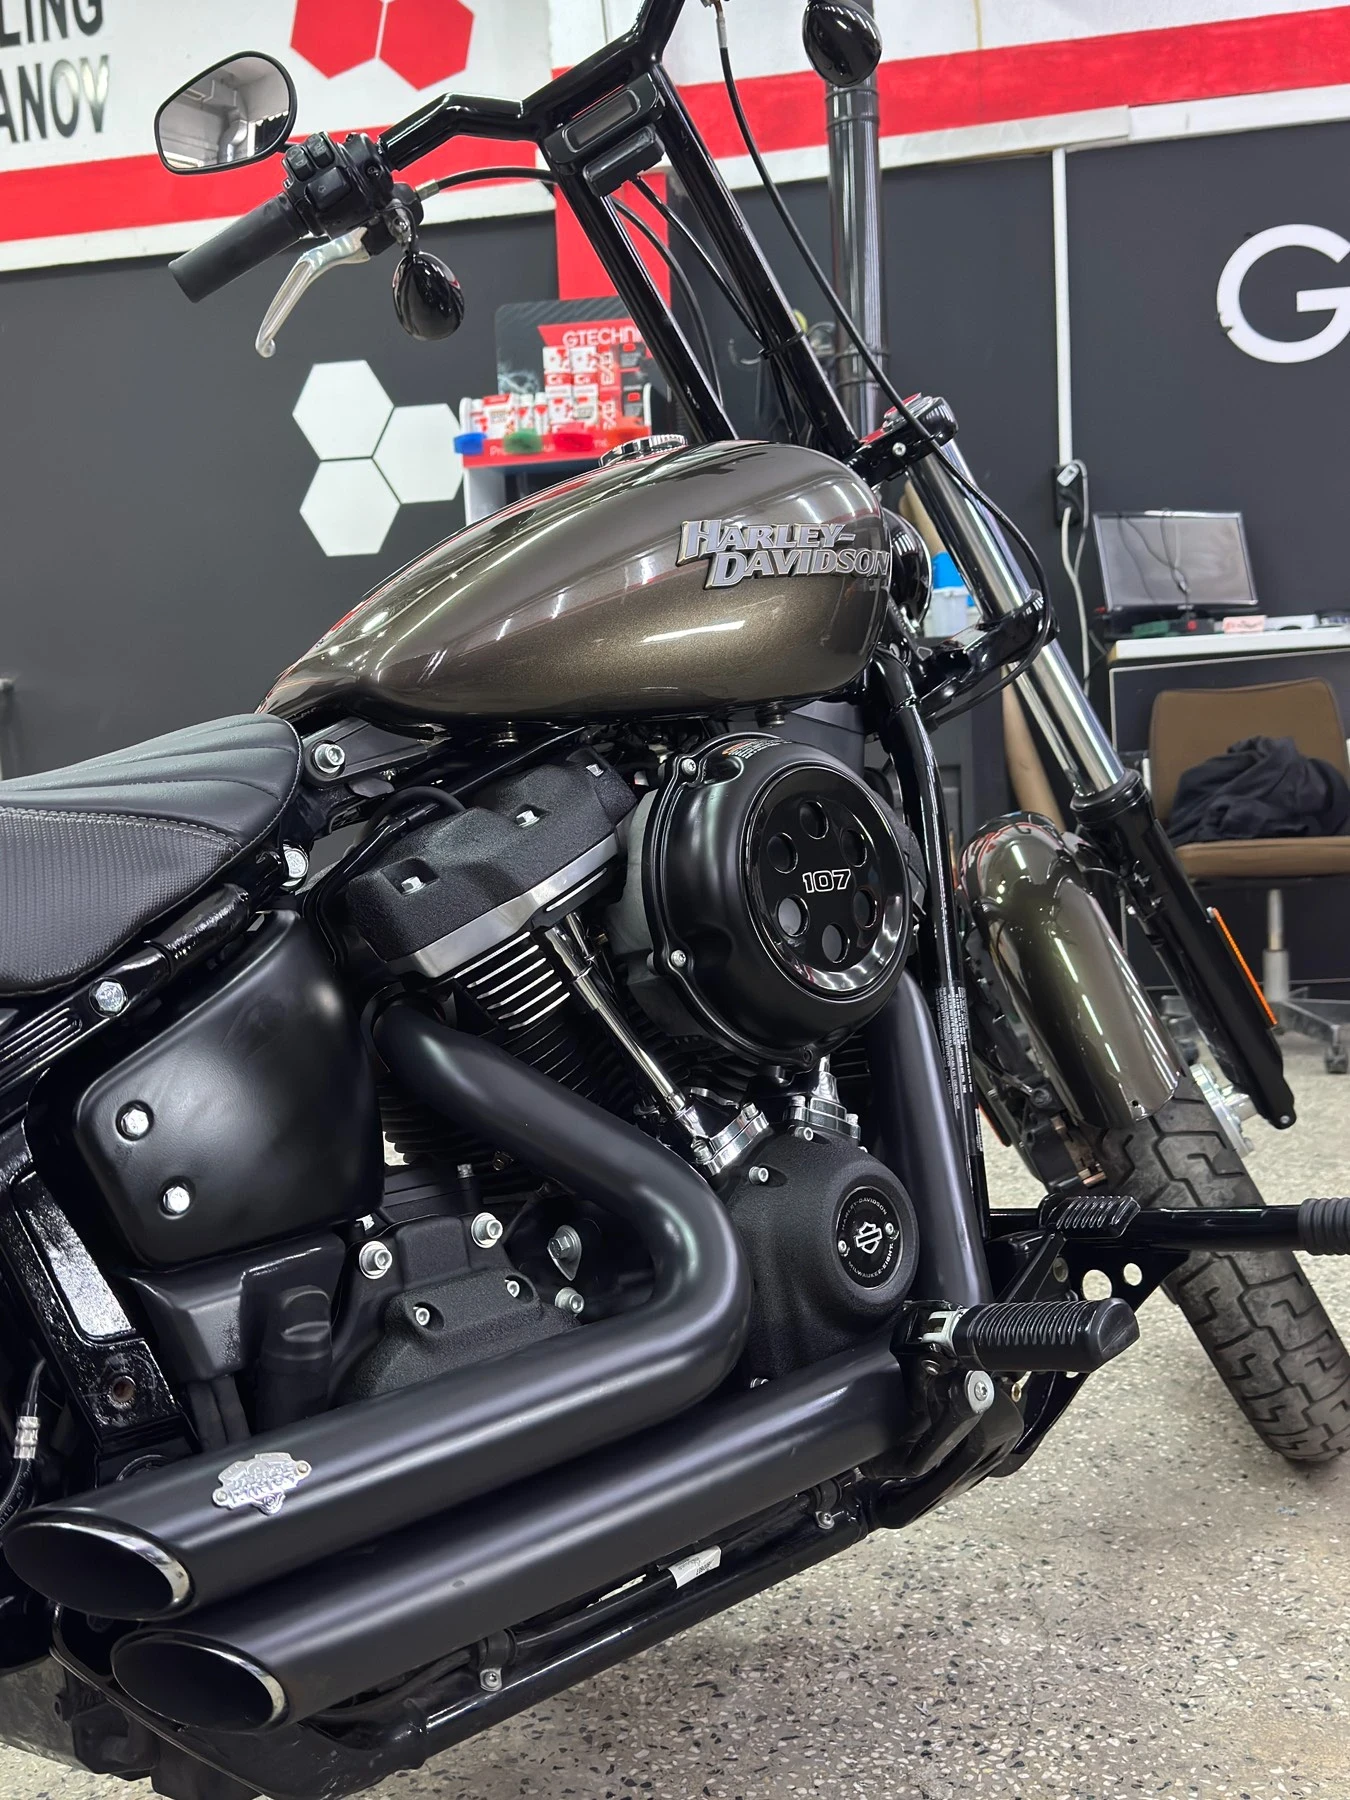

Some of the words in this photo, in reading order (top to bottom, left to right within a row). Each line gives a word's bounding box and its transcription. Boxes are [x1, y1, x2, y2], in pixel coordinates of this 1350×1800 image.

[676, 519, 856, 567] HARLEY-
[703, 548, 890, 590] DAVIDSON
[802, 869, 851, 893] 107
